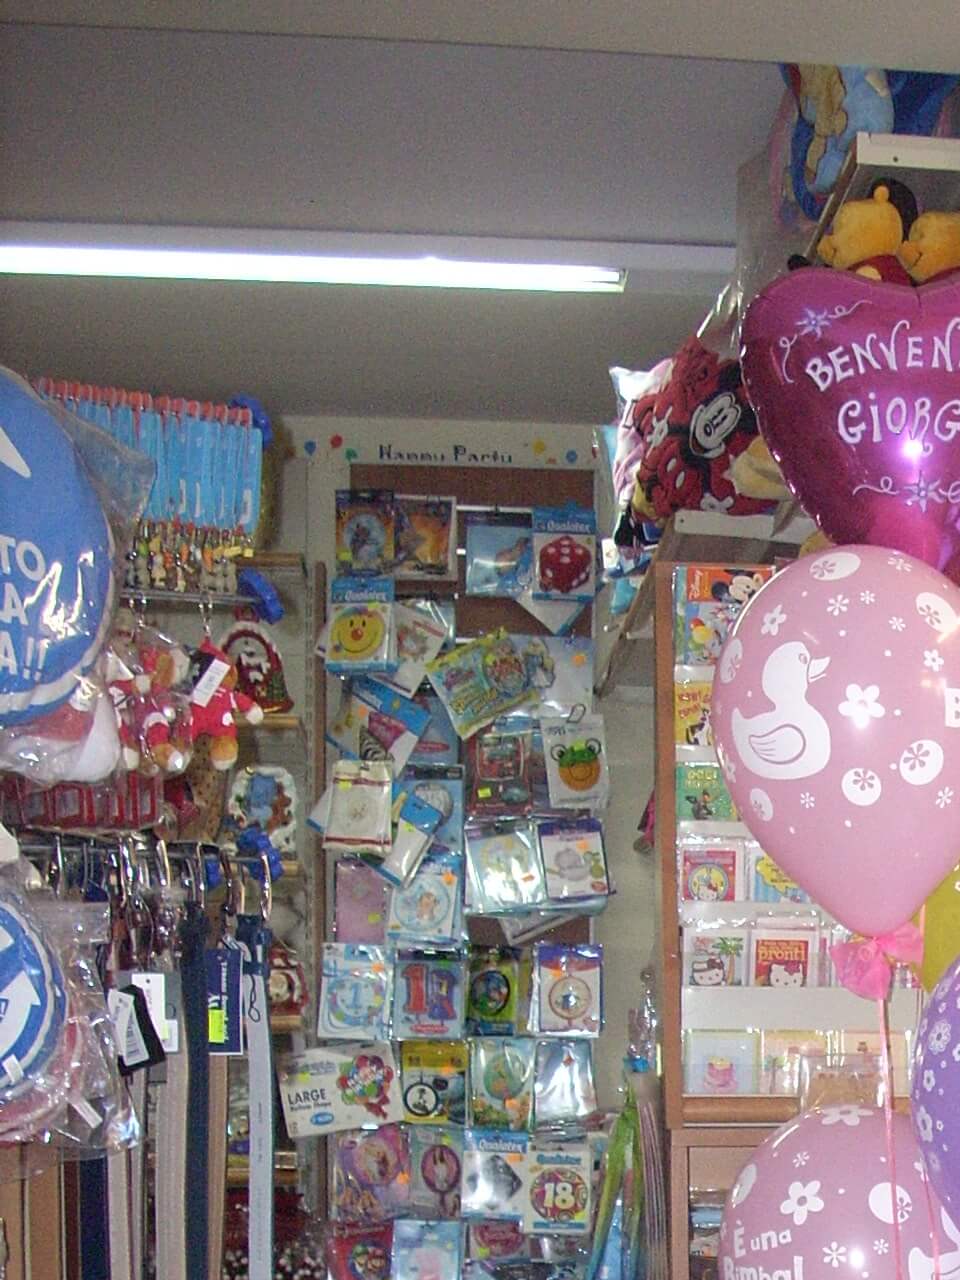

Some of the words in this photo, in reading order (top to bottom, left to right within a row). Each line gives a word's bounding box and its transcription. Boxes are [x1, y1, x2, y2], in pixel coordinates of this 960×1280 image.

[288, 1088, 326, 1105] LARGE
[544, 1183, 576, 1209] 18
[751, 1229, 792, 1251] una
